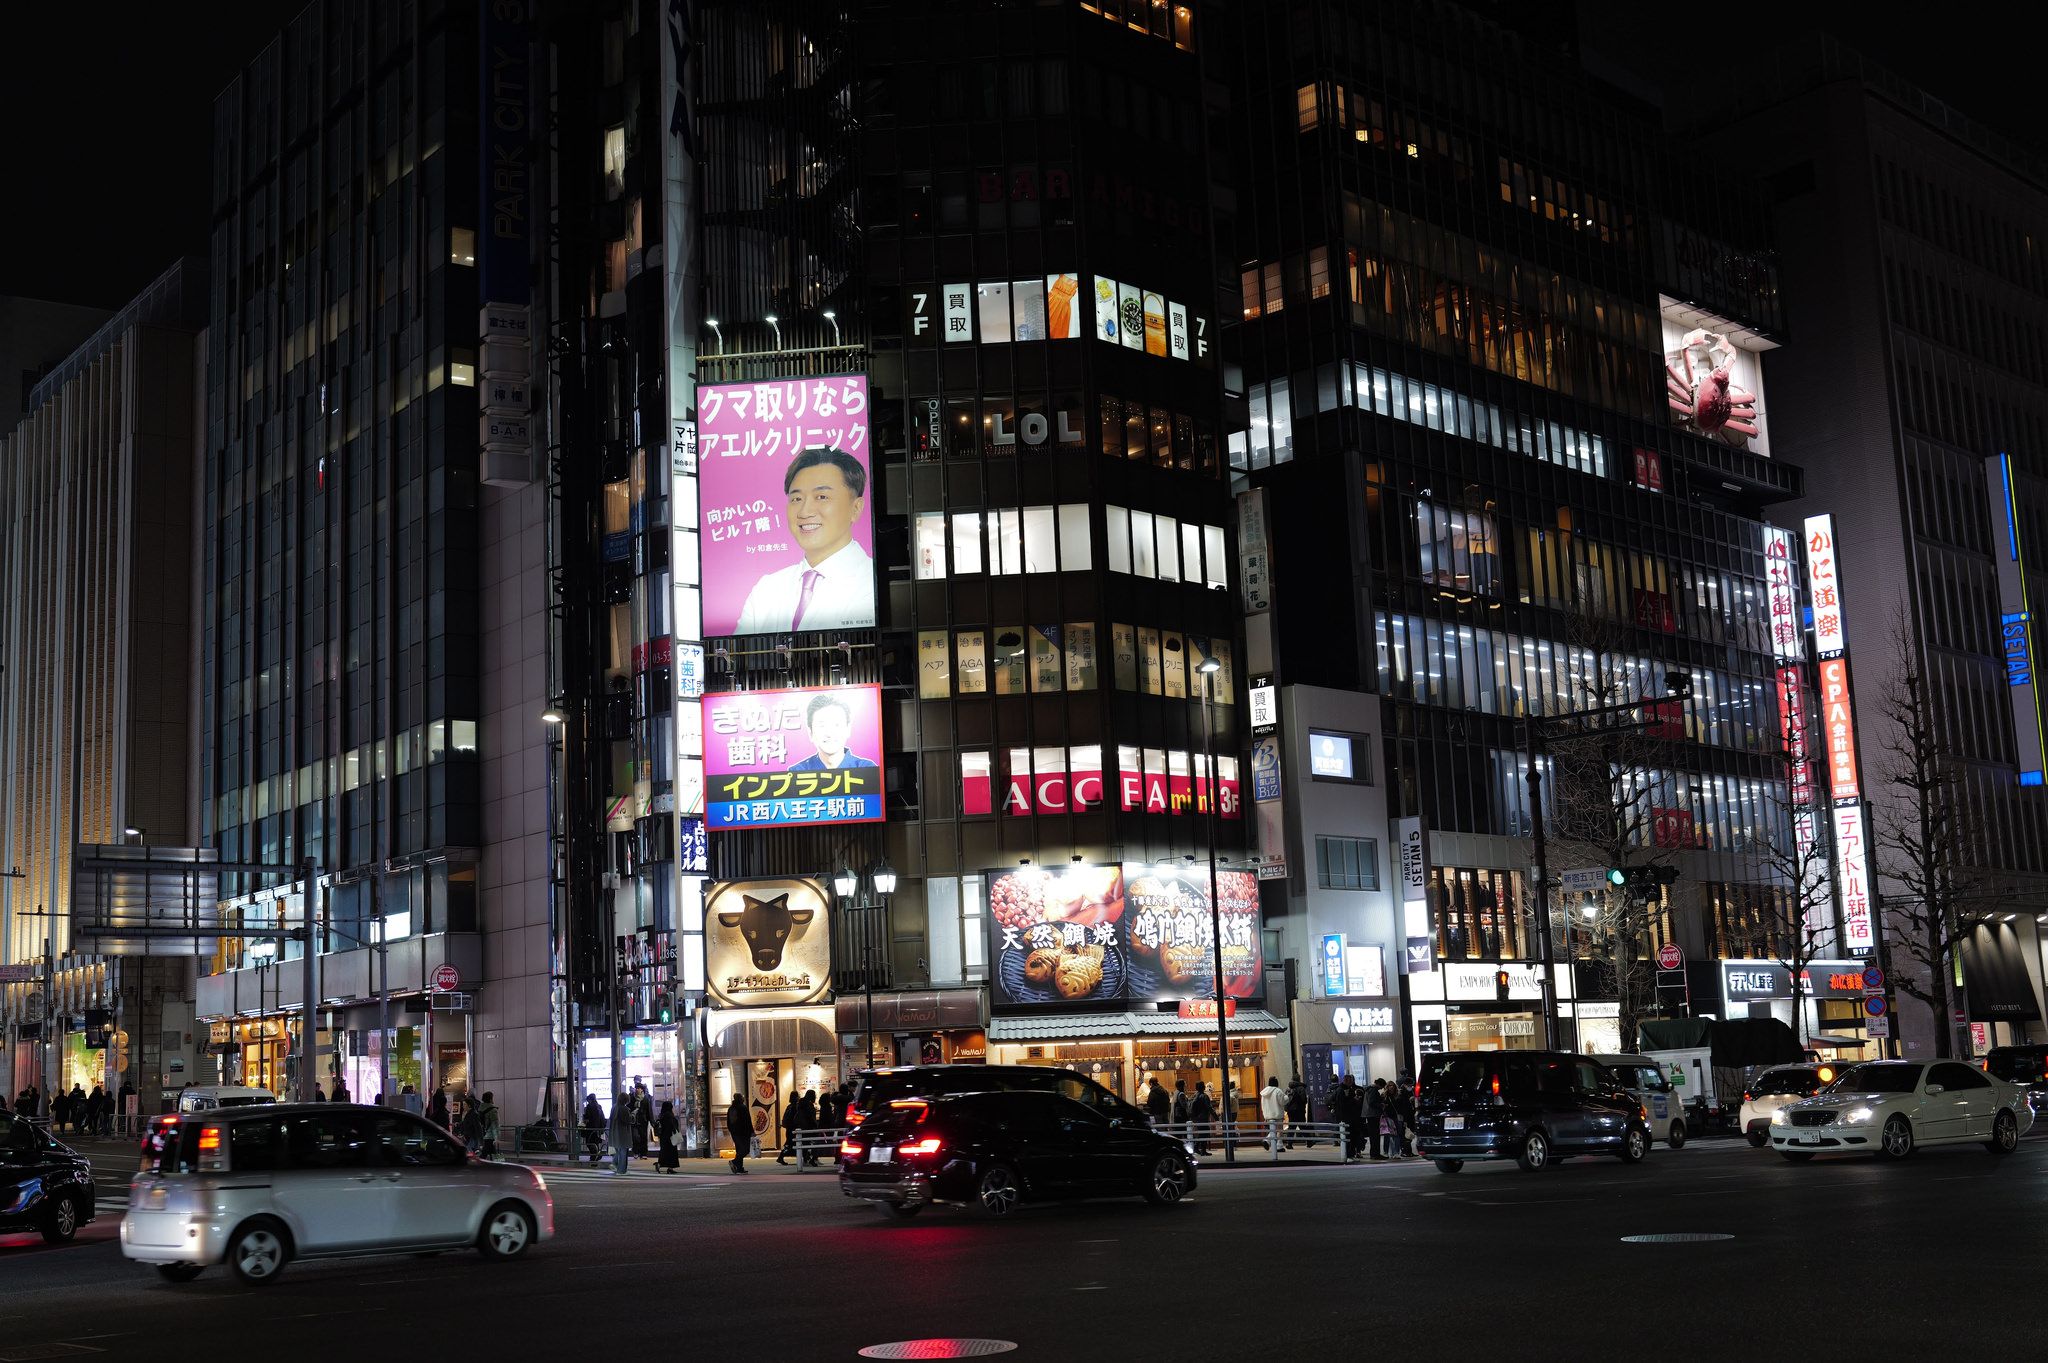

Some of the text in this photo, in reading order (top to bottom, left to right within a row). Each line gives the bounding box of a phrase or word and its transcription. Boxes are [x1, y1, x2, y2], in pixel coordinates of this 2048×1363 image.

[489, 317, 526, 329] 富士そば
[912, 293, 929, 336] 7F
[949, 294, 967, 333] 買取
[1172, 312, 1186, 352] 買取
[1195, 317, 1208, 358] 7F
[700, 378, 866, 425] クマ取りなら
[928, 398, 940, 448] OPEN
[993, 410, 1082, 446] LOL
[699, 422, 867, 460] アエルクリニック
[707, 498, 773, 525] 向かいの、
[746, 545, 756, 553] by
[1809, 531, 1838, 637] かに道楽
[1638, 595, 1669, 626] 会計
[921, 637, 982, 649] 薄毛 治療
[1043, 627, 1057, 637] 4F
[679, 647, 701, 658] マヤ
[959, 658, 984, 669] AGA
[1142, 657, 1158, 666] AGA
[680, 660, 695, 695] 歯科
[960, 680, 973, 688] TEL
[974, 680, 985, 688] 03
[1256, 677, 1266, 687] 7F
[712, 703, 802, 734] きぬた
[1254, 692, 1268, 722] 買取
[1645, 711, 1682, 725] proessional
[1825, 664, 1852, 781] CPA会計学院
[727, 735, 787, 766] 歯科
[722, 770, 864, 799] インプラント
[1258, 785, 1279, 798] BiZ
[723, 797, 865, 822] JR西八王子駅前
[1220, 786, 1240, 812] 3F
[681, 833, 695, 870] ウイル
[1409, 830, 1424, 887] ISETAN 5
[1404, 860, 1412, 880] PARK
[1564, 870, 1604, 883] 新宿五丁目
[1841, 815, 1869, 939] テアトル新宿
[1000, 920, 1118, 950] 天然鯛焼
[1661, 953, 1679, 962] 消火栓
[1853, 946, 1869, 956] B1F
[438, 974, 456, 983] 消火栓
[1459, 975, 1533, 989] EMPORIO RMANI
